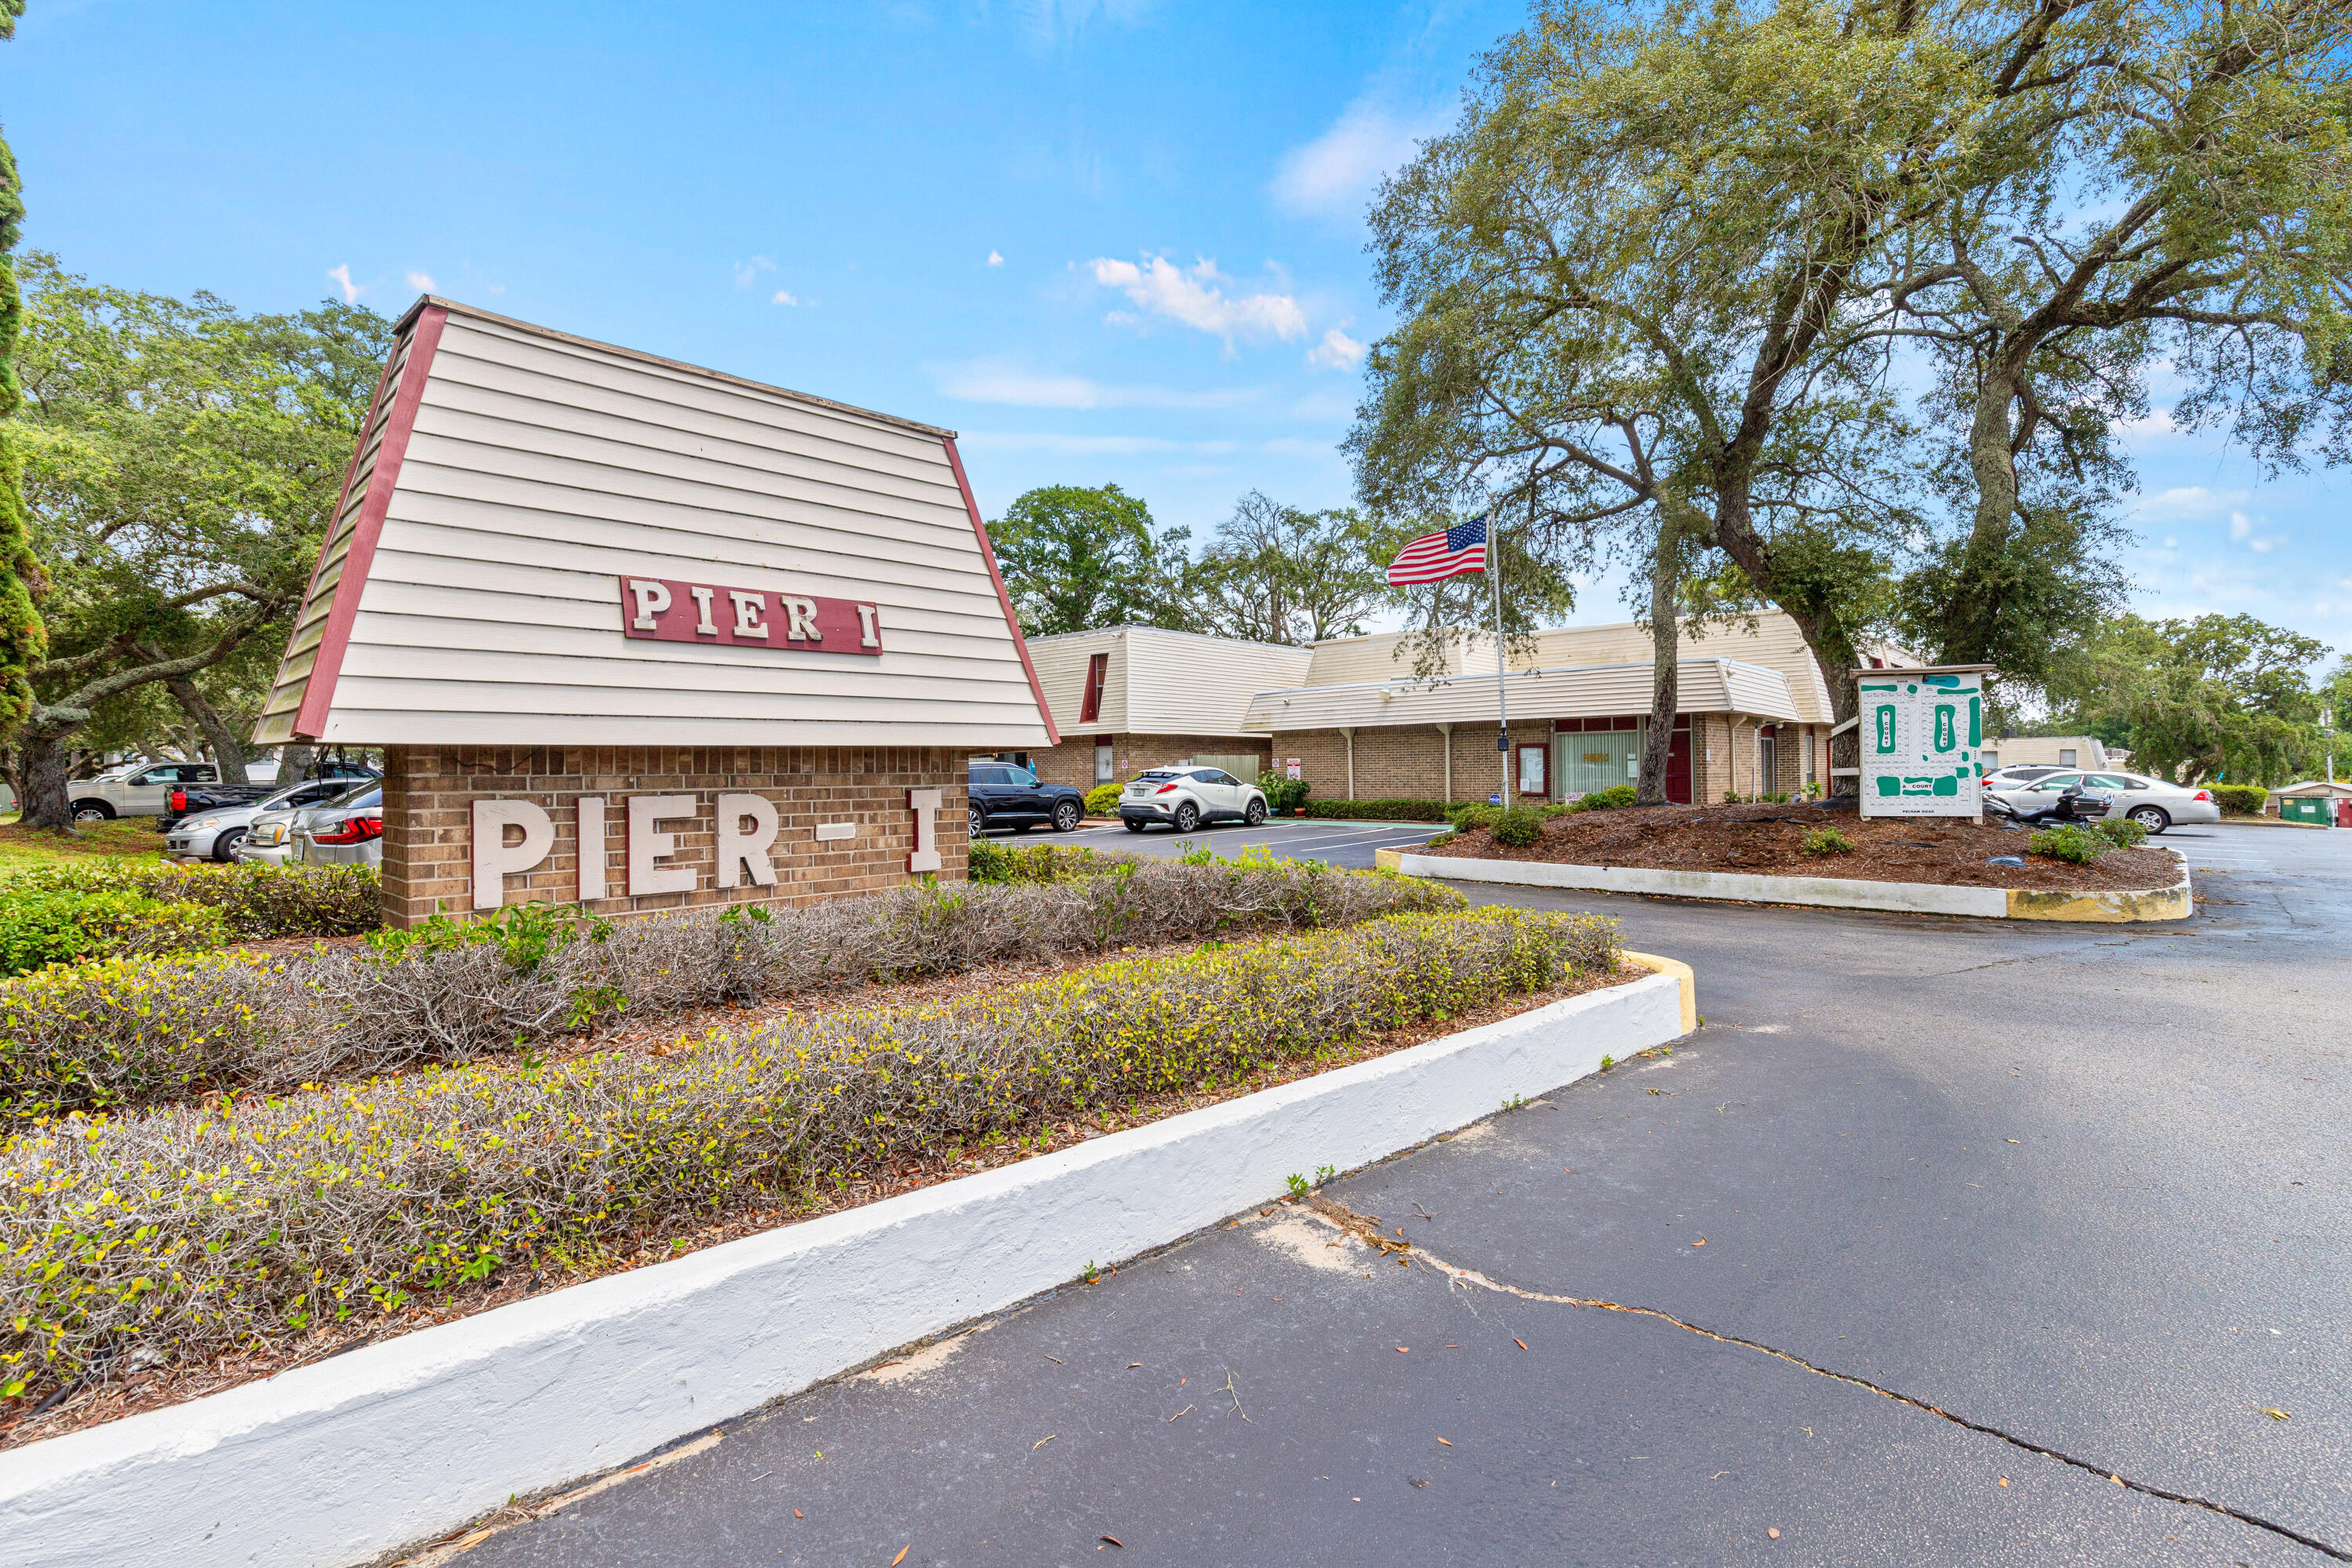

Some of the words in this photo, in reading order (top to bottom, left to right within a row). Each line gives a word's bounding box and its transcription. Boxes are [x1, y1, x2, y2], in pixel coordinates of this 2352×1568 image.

[630, 579, 823, 641] PIER
[856, 604, 879, 648] I
[471, 793, 779, 909] PIER
[906, 789, 942, 873] I
